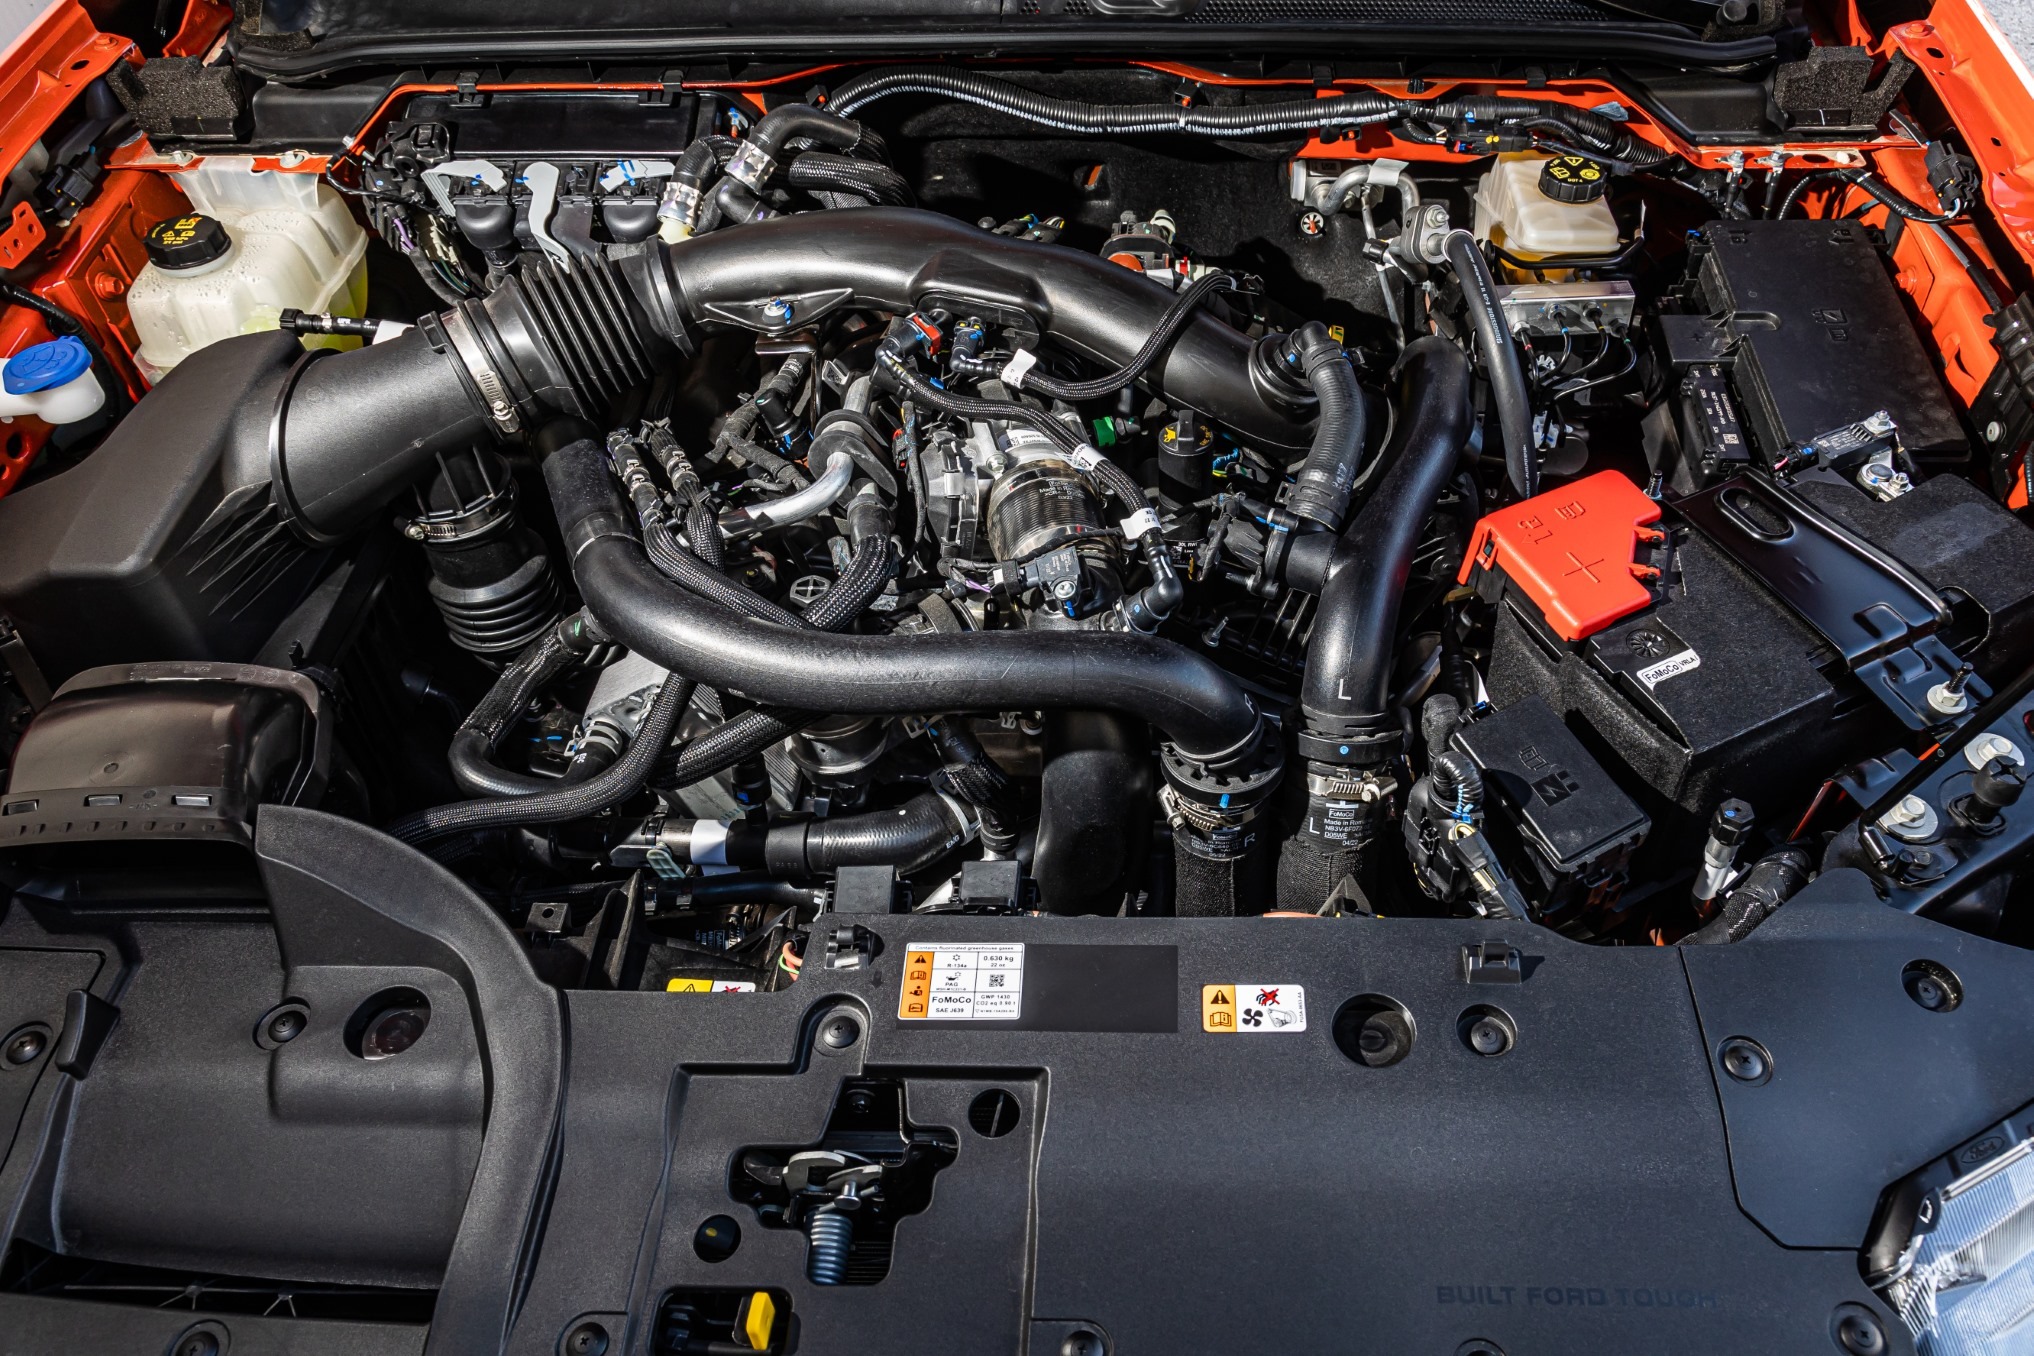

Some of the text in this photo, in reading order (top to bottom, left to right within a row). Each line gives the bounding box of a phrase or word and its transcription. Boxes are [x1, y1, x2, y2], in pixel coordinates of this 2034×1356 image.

[1645, 664, 1679, 681] FoMoCo
[1338, 678, 1351, 700] L
[1309, 817, 1320, 835] L
[945, 834, 960, 850] ENG
[1244, 832, 1256, 848] R
[932, 996, 972, 1004] FoMoCo
[1437, 1285, 1717, 1308] BUILT FORD TOUGH
